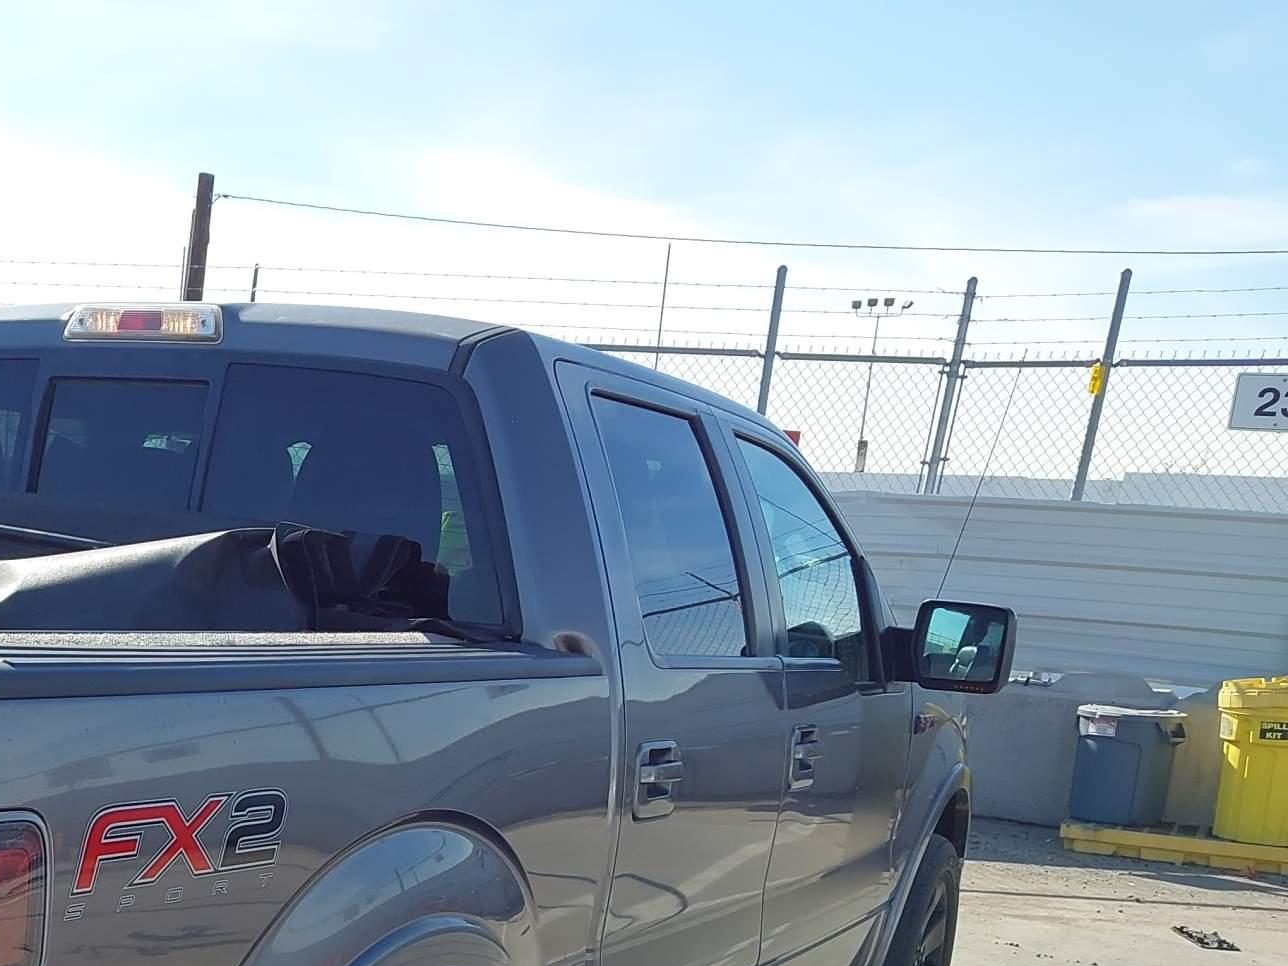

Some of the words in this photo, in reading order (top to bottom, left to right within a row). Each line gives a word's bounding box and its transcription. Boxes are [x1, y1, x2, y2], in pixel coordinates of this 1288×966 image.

[1264, 731, 1284, 740] KIT
[69, 786, 289, 898] FX2
[63, 872, 274, 922] SPORT
